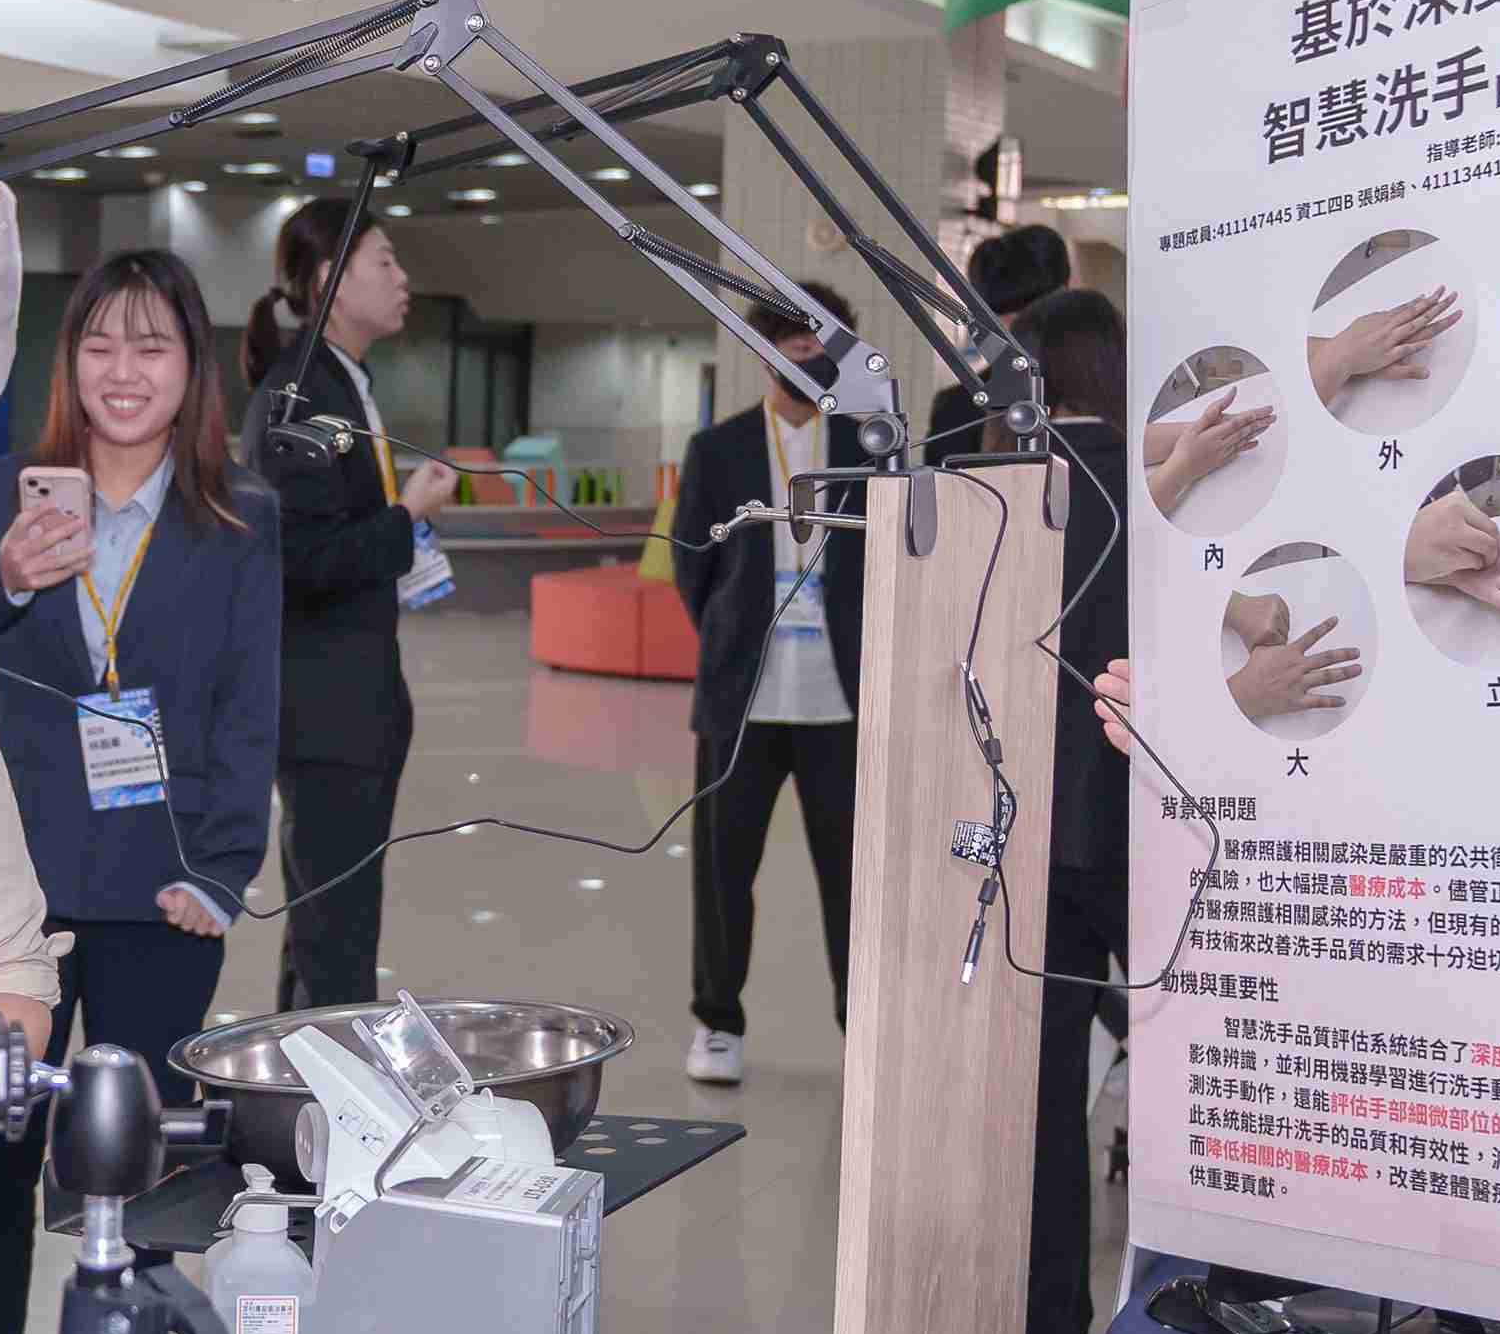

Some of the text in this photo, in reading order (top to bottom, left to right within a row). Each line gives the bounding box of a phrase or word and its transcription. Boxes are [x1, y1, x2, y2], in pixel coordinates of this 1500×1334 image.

[1295, 194, 1355, 223] 資工四B
[1377, 438, 1405, 471] 外
[1285, 748, 1310, 778] 大
[1160, 795, 1257, 822] 背景與問題
[1160, 969, 1279, 1003] 動機與重要性
[1188, 1165, 1288, 1200] 供重要貢獻。
